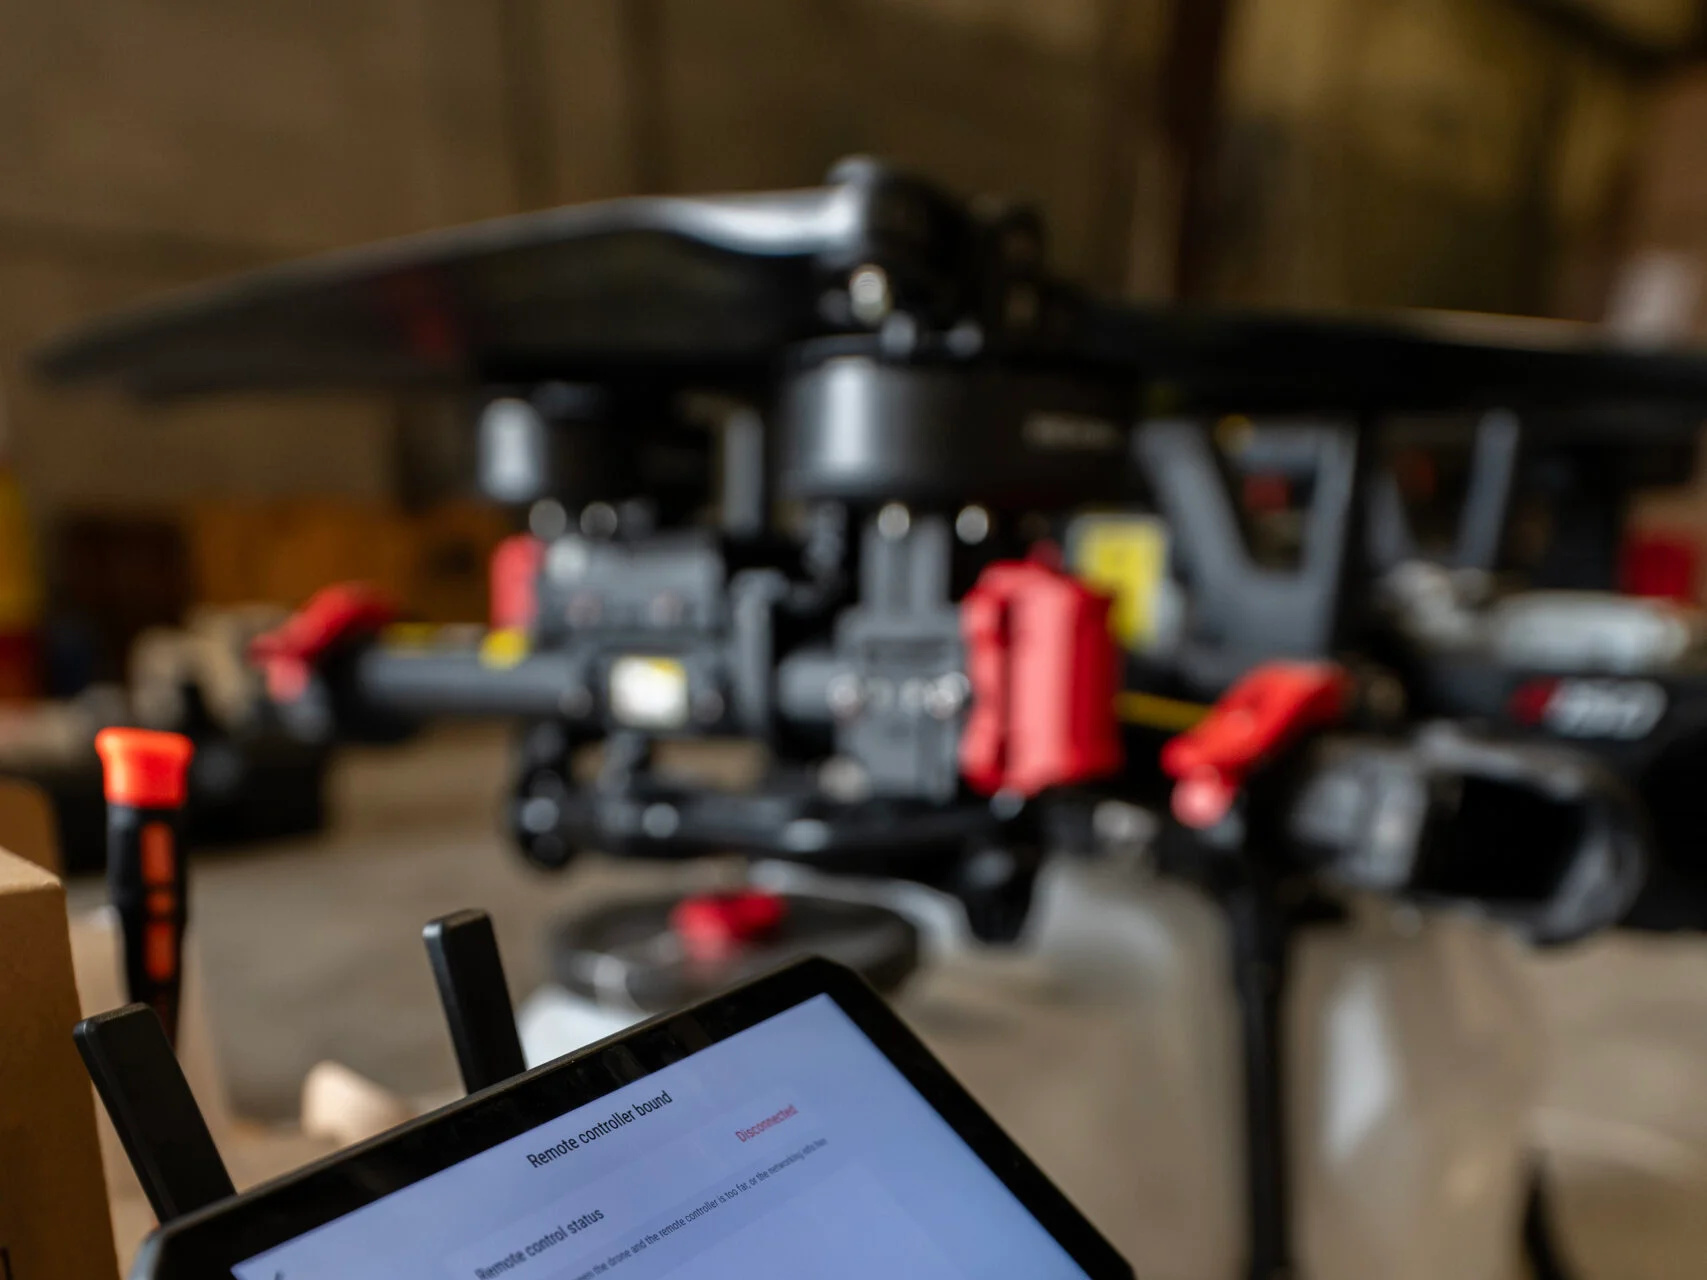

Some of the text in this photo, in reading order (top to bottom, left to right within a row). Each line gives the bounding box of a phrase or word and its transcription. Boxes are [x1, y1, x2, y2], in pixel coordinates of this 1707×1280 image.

[526, 1090, 673, 1168] Remote controller bound
[735, 1104, 799, 1143] Disconnected
[525, 1225, 569, 1257] control
[567, 1209, 605, 1234] status
[592, 1262, 609, 1275] the
[607, 1249, 631, 1267] drone
[630, 1238, 647, 1254] and
[645, 1232, 660, 1245] the
[658, 1218, 686, 1238] remote
[685, 1199, 719, 1222] controller
[718, 1194, 727, 1204] is
[725, 1188, 739, 1200] too
[749, 1177, 757, 1186] or
[756, 1171, 769, 1181] the
